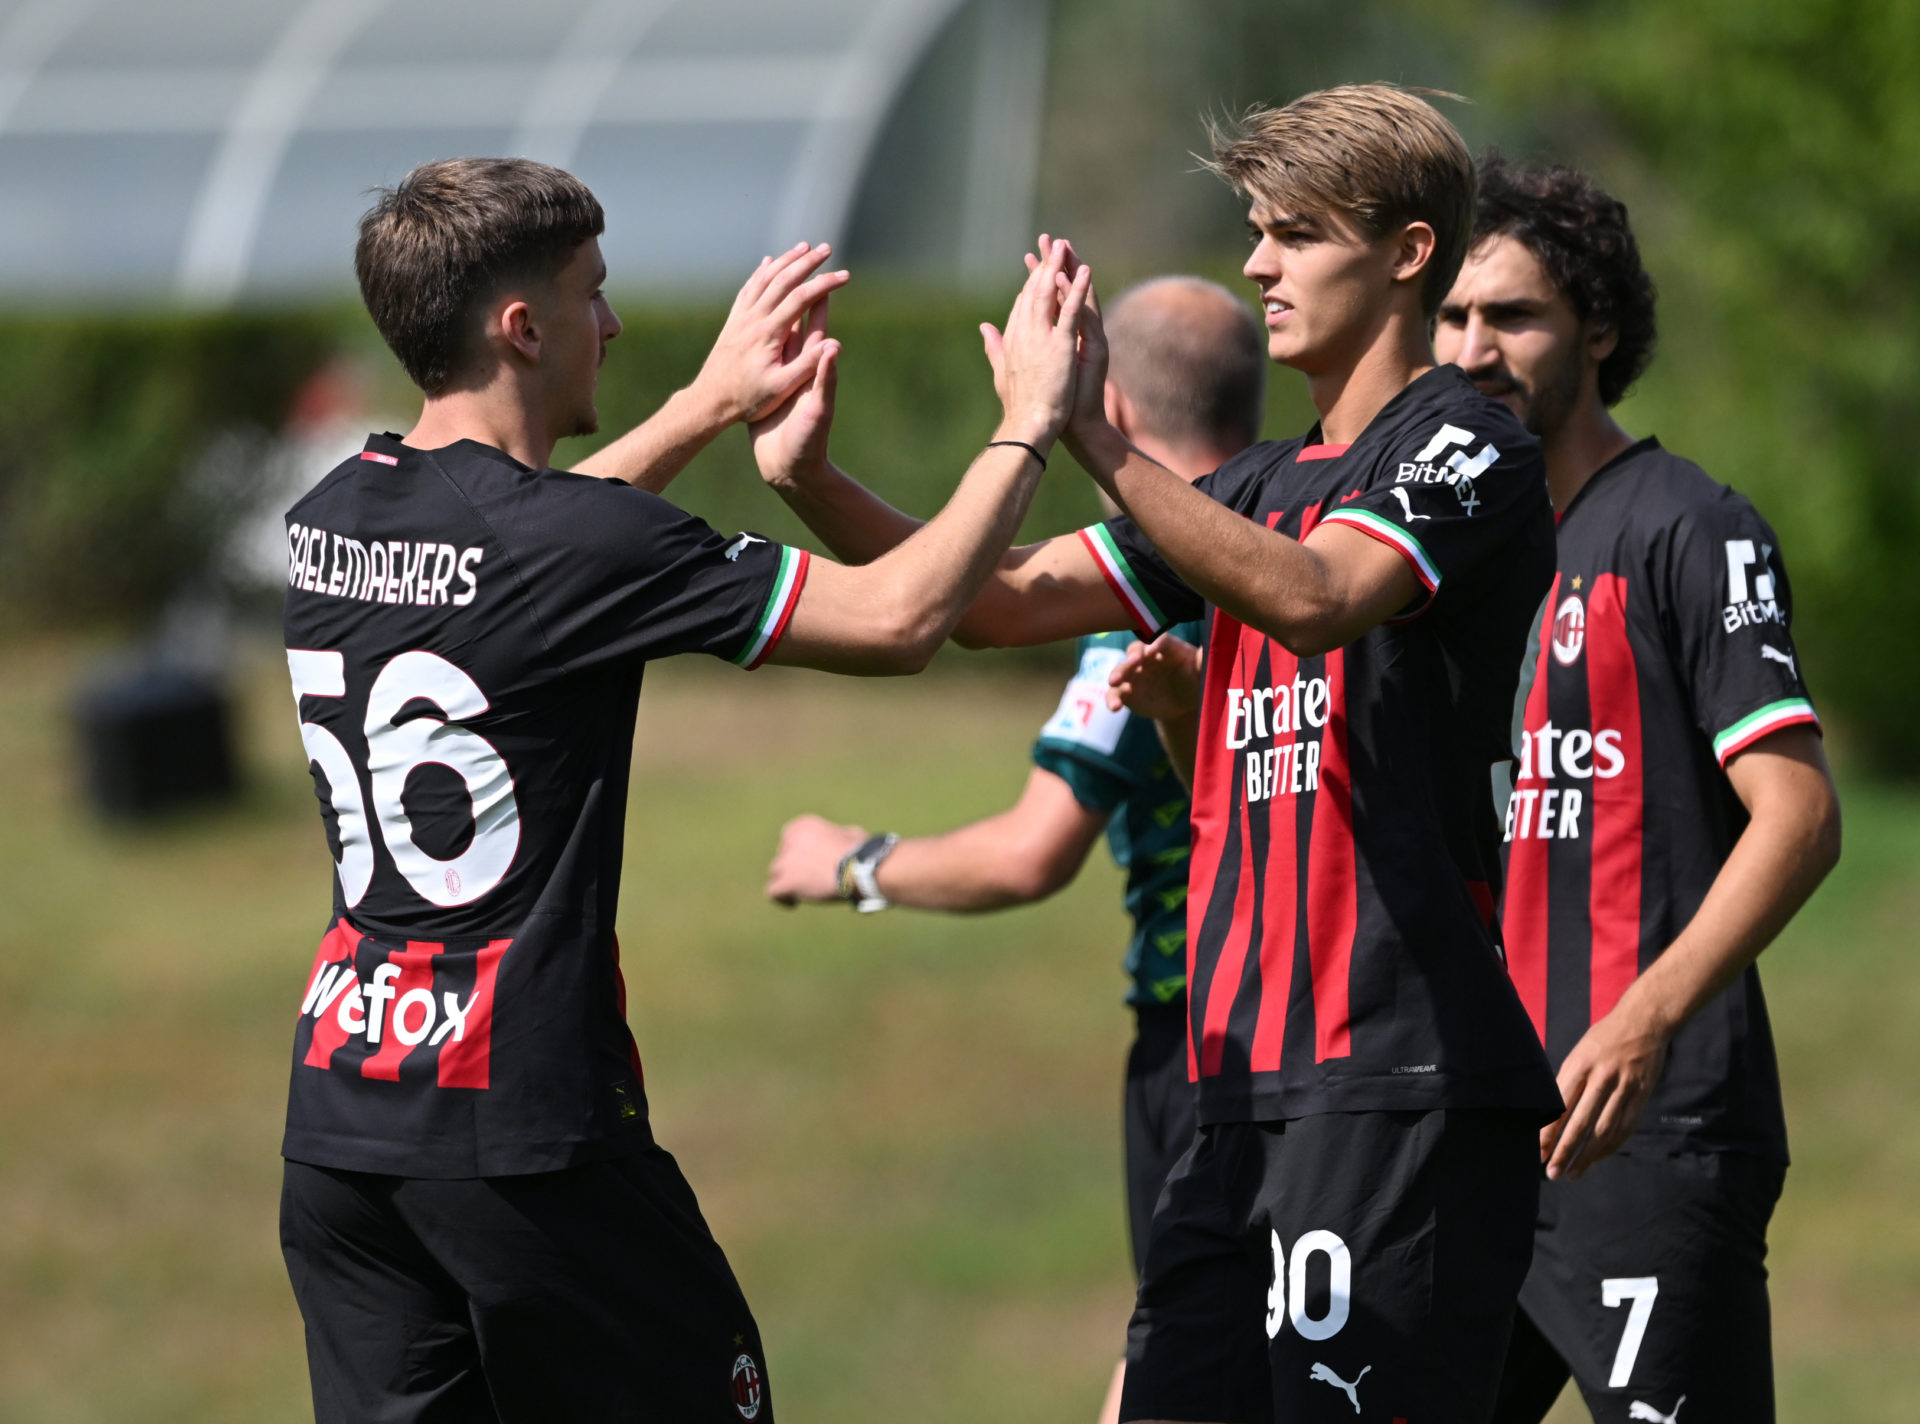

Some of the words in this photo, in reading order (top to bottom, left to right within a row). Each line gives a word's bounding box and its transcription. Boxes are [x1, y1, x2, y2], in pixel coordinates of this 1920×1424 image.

[288, 522, 484, 606] SAELEMAEKERS
[286, 648, 522, 909] 56
[1246, 740, 1320, 803] BETTER
[301, 960, 480, 1046] wefox
[1601, 1276, 1659, 1388] 7
